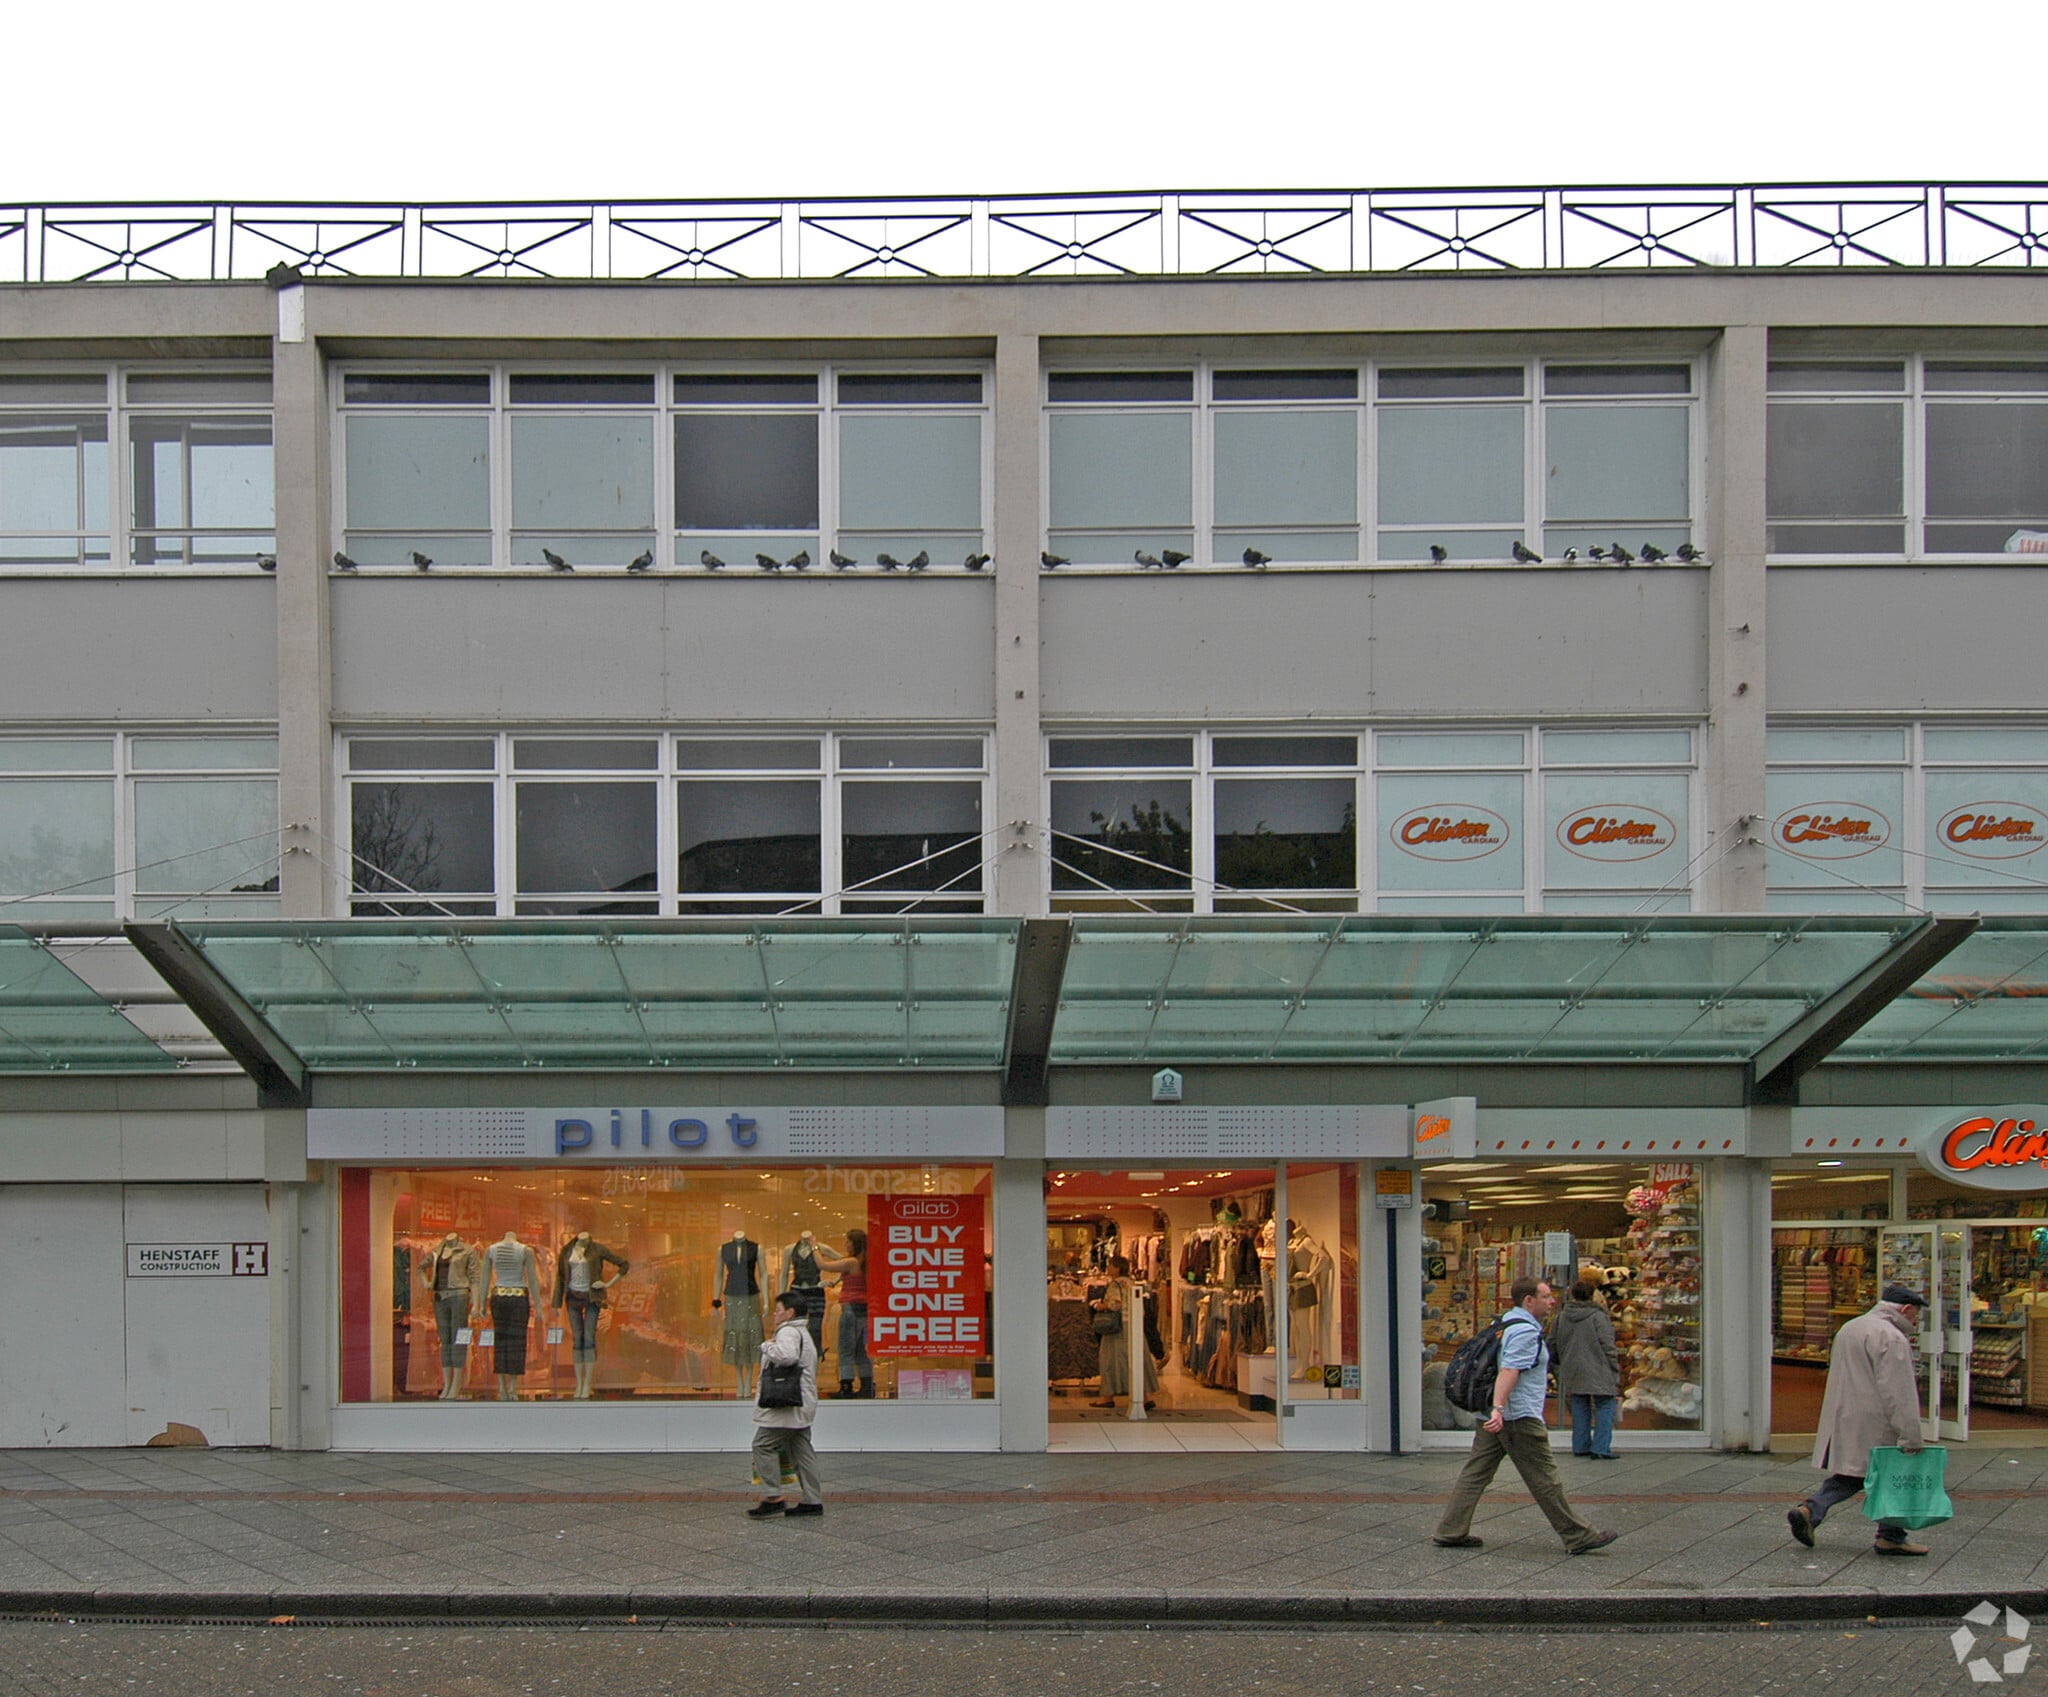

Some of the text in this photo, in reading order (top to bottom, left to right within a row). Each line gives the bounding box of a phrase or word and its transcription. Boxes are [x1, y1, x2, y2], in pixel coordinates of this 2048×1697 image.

[1401, 816, 1490, 845] Clinton
[1567, 817, 1656, 846] Clinton
[1782, 814, 1872, 844] Clinton
[1947, 813, 2035, 843] Clinton
[1461, 837, 1499, 845] CARDIAU
[2006, 835, 2044, 843] CARDIAU
[555, 1109, 757, 1155] pilot
[651, 1210, 719, 1226] FREE
[902, 1201, 949, 1217] pilot
[888, 1225, 965, 1244] BUY
[140, 1250, 219, 1260] HENSTAFF
[235, 1245, 266, 1275] H
[888, 1248, 964, 1266] ONE
[891, 1271, 961, 1289] GET
[888, 1293, 965, 1311] ONE
[873, 1317, 980, 1342] FREE
